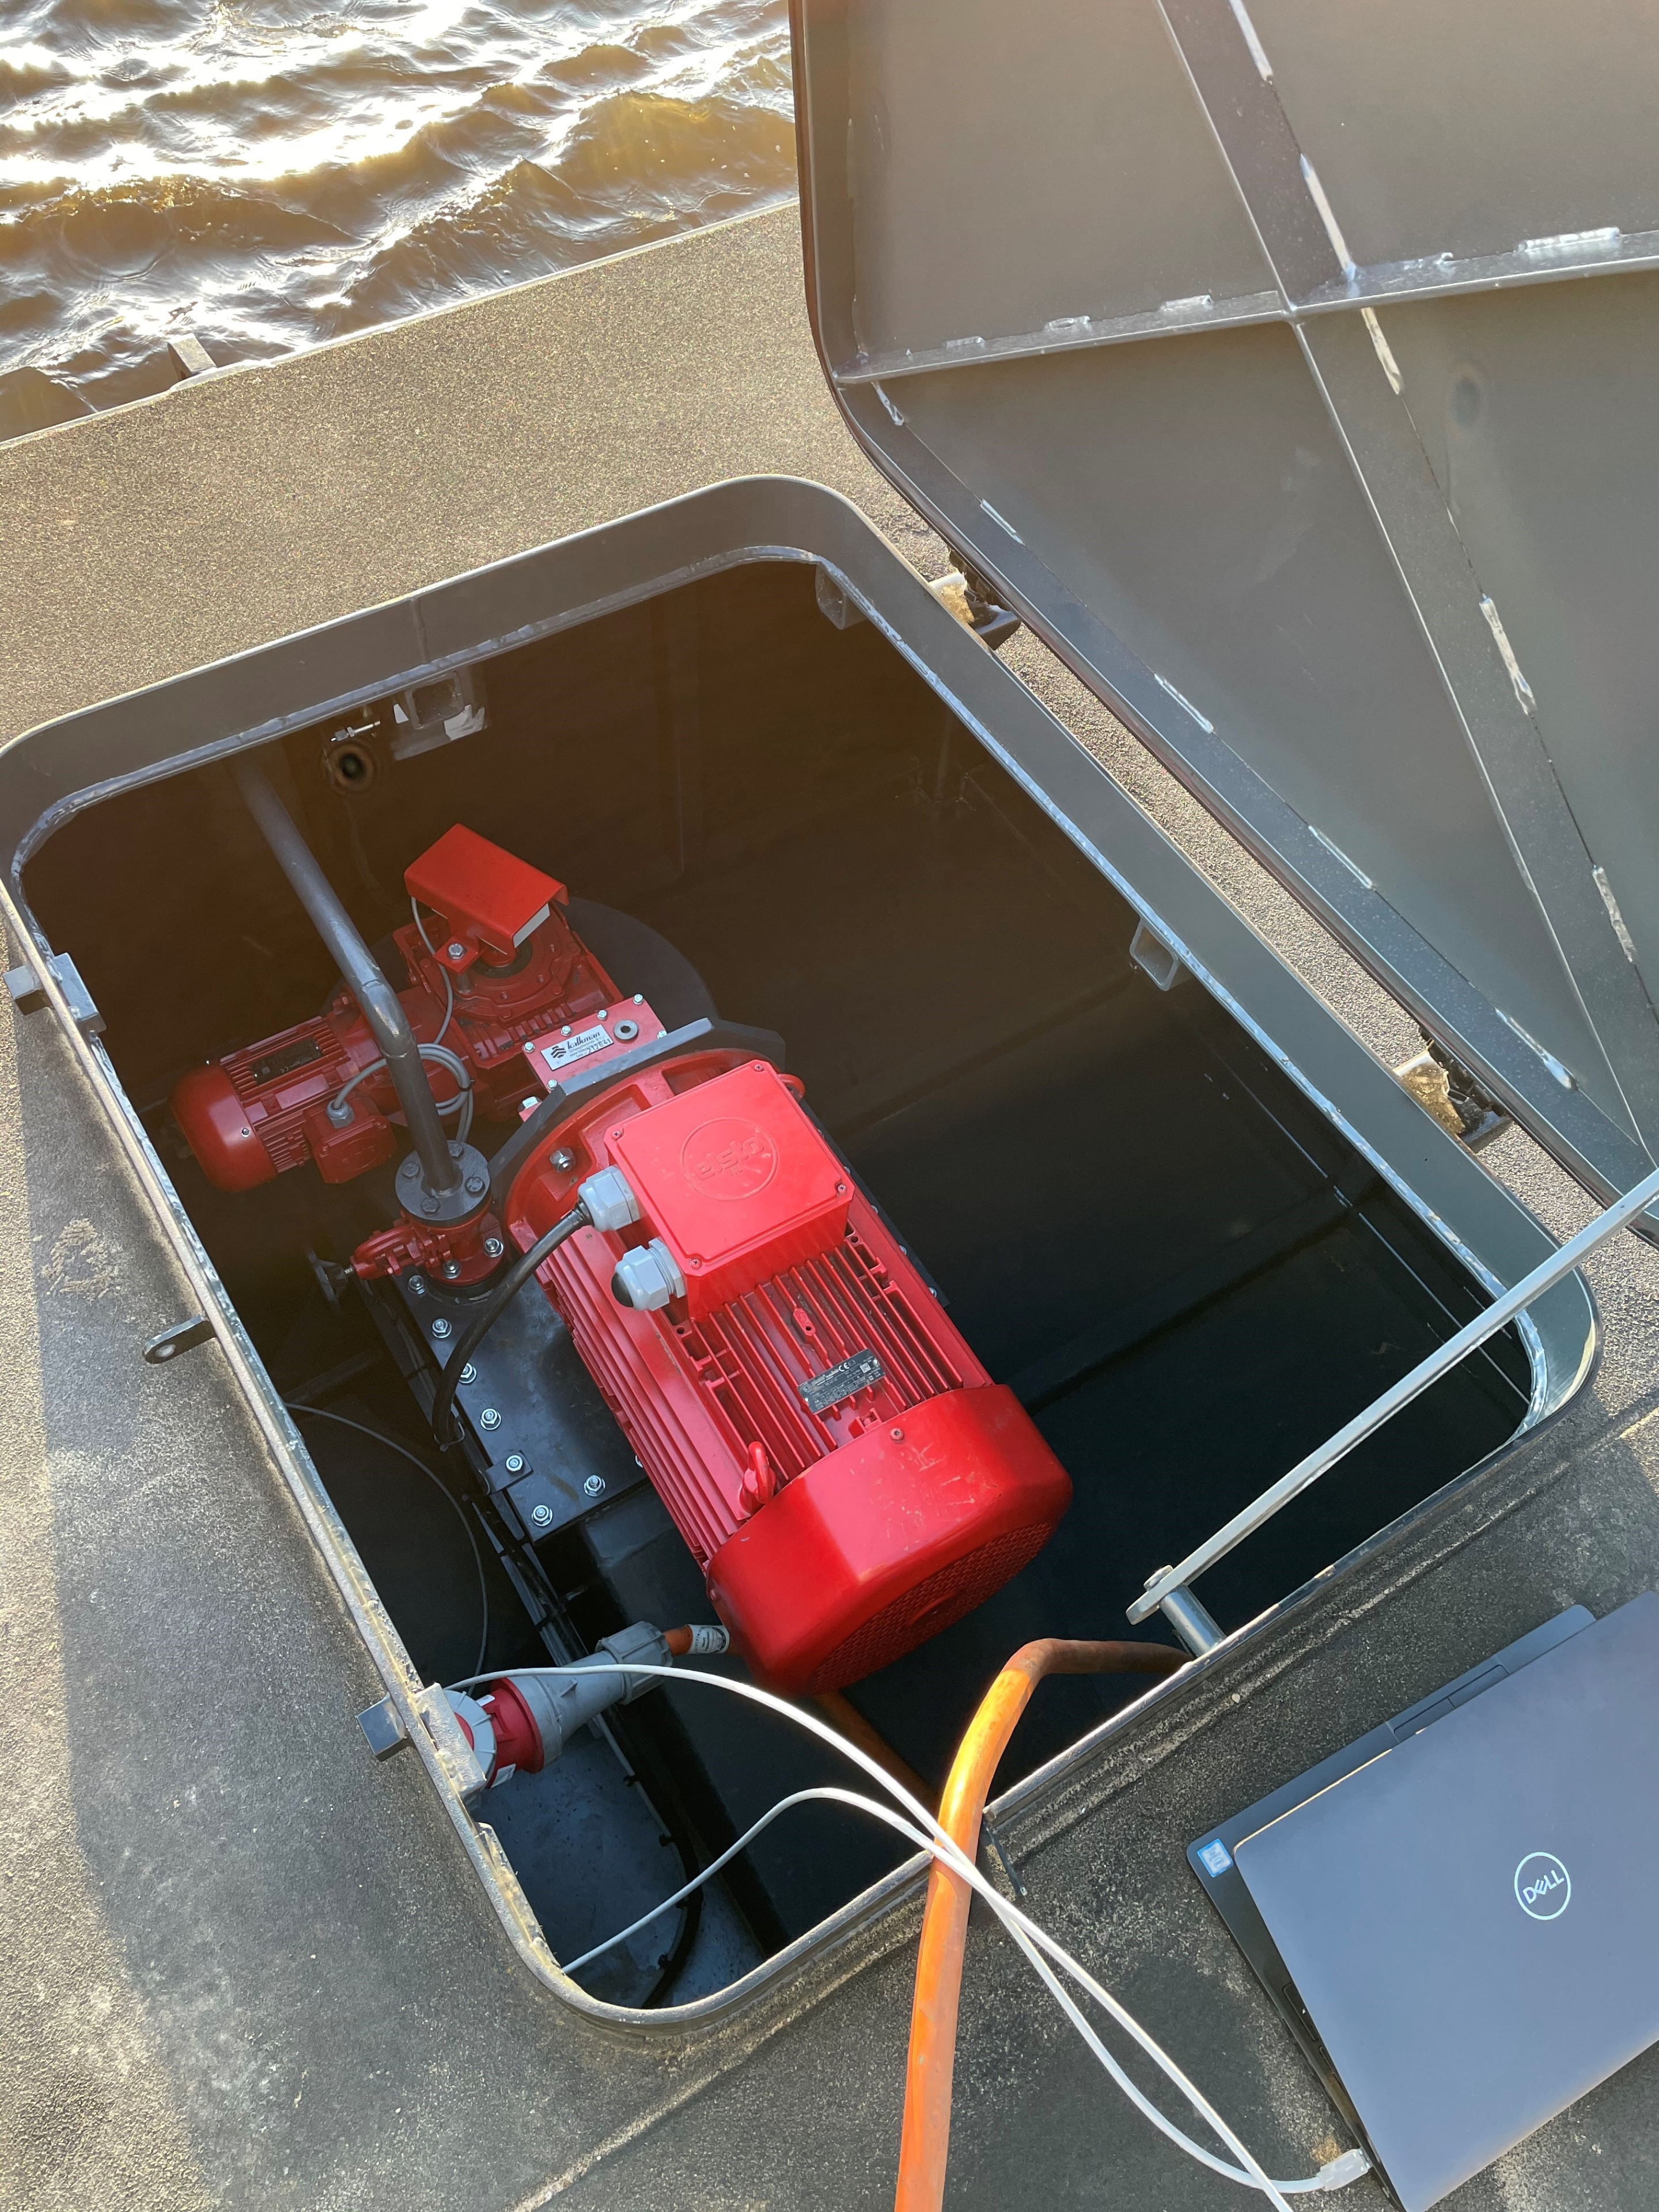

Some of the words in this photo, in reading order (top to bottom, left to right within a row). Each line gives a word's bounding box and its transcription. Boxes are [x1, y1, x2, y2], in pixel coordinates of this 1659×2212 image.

[567, 1032, 600, 1049] kalkman
[694, 1136, 764, 1181] elsto
[838, 1362, 850, 1372] CE
[1522, 1870, 1565, 1904] DELL
